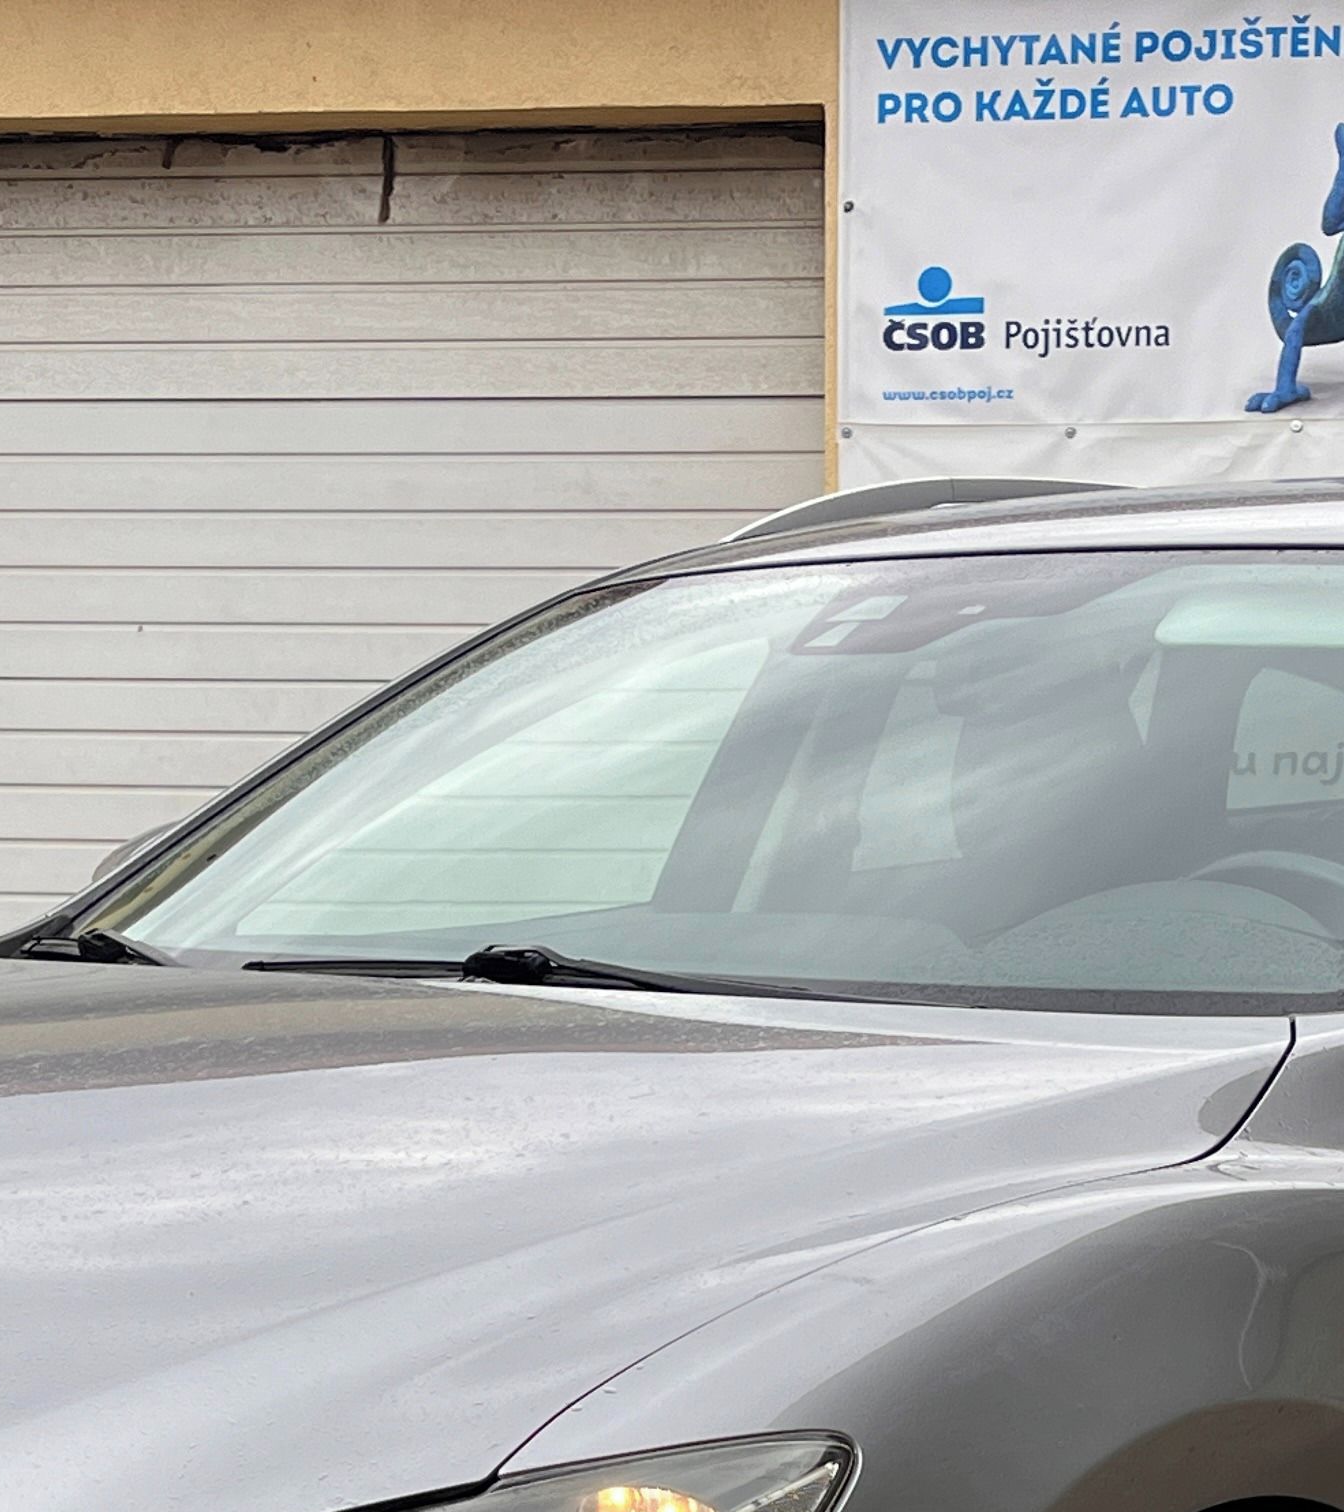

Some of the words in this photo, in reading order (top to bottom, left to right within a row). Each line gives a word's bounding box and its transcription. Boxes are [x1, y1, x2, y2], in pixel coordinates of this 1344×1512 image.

[876, 21, 1120, 70] VYCHYTANÉ
[877, 91, 963, 124] PRO
[975, 76, 1110, 122] KAŽDÉ
[1119, 83, 1234, 118] AUTO
[883, 318, 986, 351] ČSOB
[1004, 316, 1171, 358] Pojišťovna
[881, 386, 1014, 402] www.csobpoj.cz
